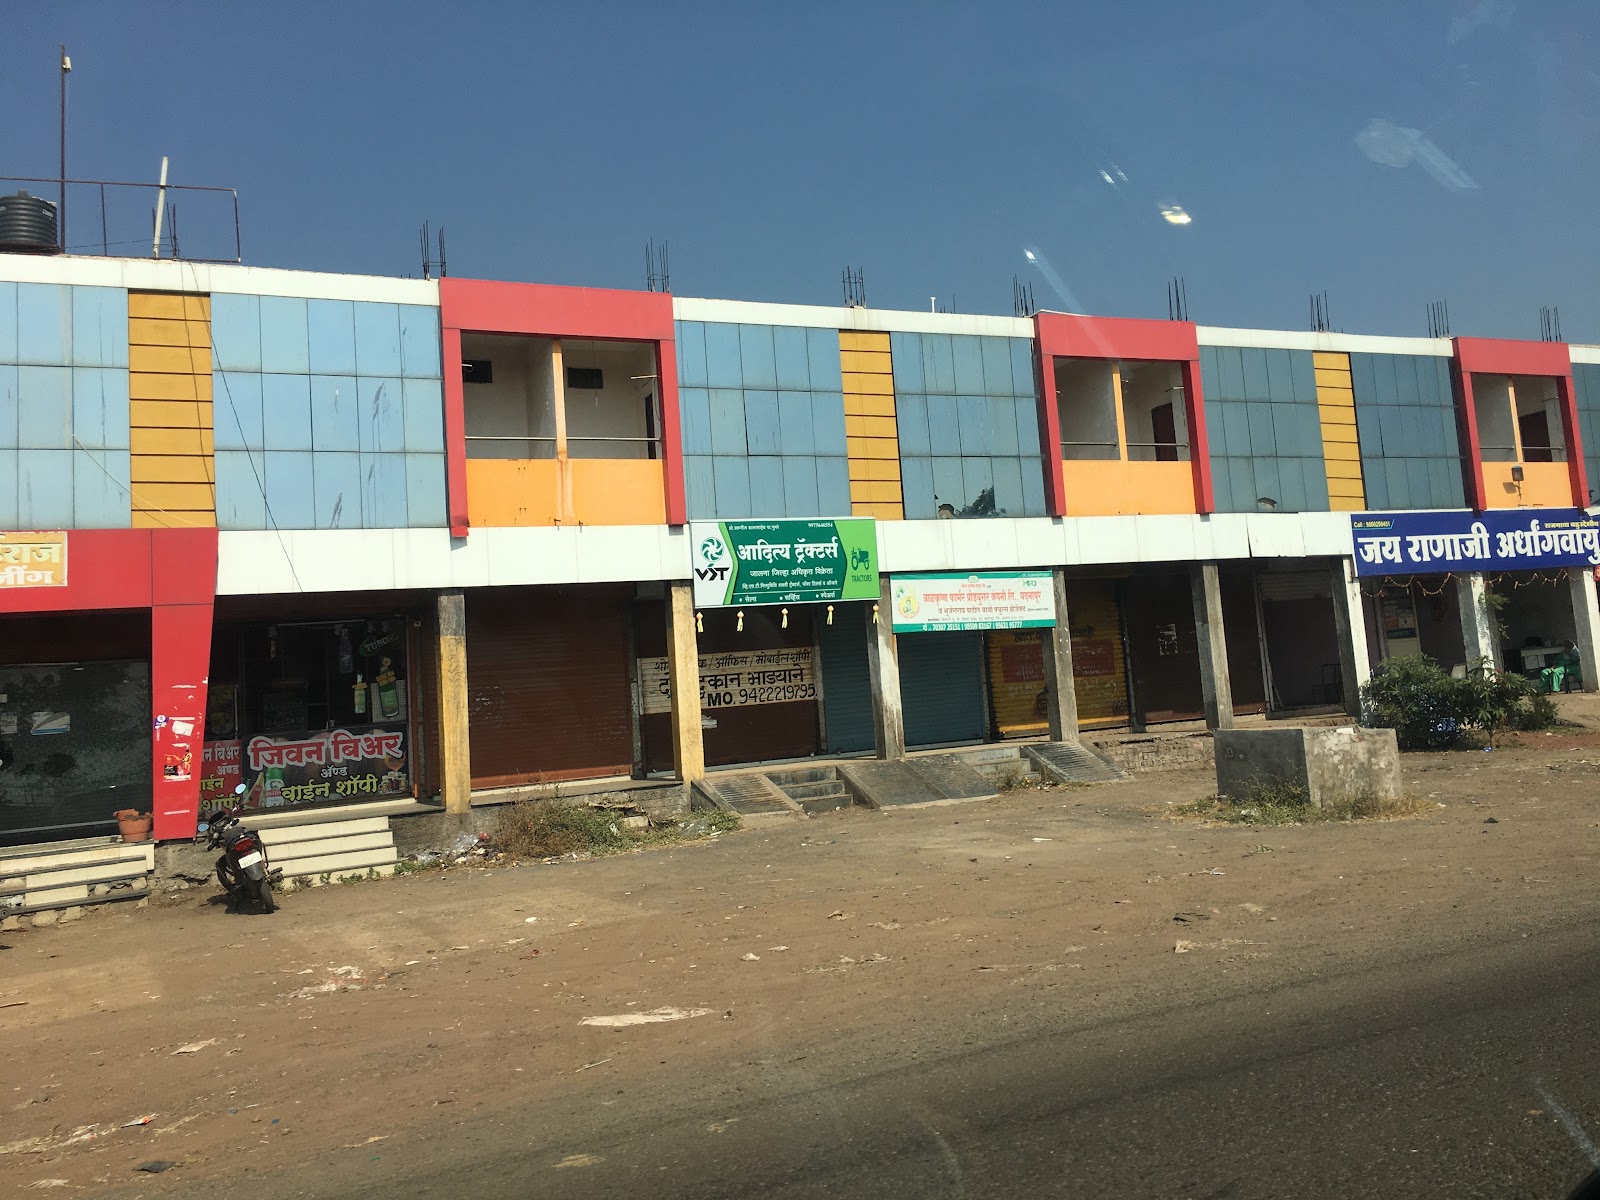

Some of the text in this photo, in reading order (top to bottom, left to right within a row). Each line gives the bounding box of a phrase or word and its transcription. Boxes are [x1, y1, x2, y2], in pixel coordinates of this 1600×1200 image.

[737, 536, 839, 564] आदित्य ट्रॅक्टर्स
[1358, 536, 1403, 564] जय
[1406, 521, 1492, 563] राणाजी
[750, 565, 834, 578] जालना जिल्हा अधिकृत विक्रेता
[851, 574, 873, 583] TRACTORS
[364, 632, 400, 653] TUBORG
[707, 692, 736, 707] MO.
[249, 736, 326, 770] जिवन
[330, 729, 404, 763] बिअर
[281, 773, 379, 802] वाईन शॉपी
